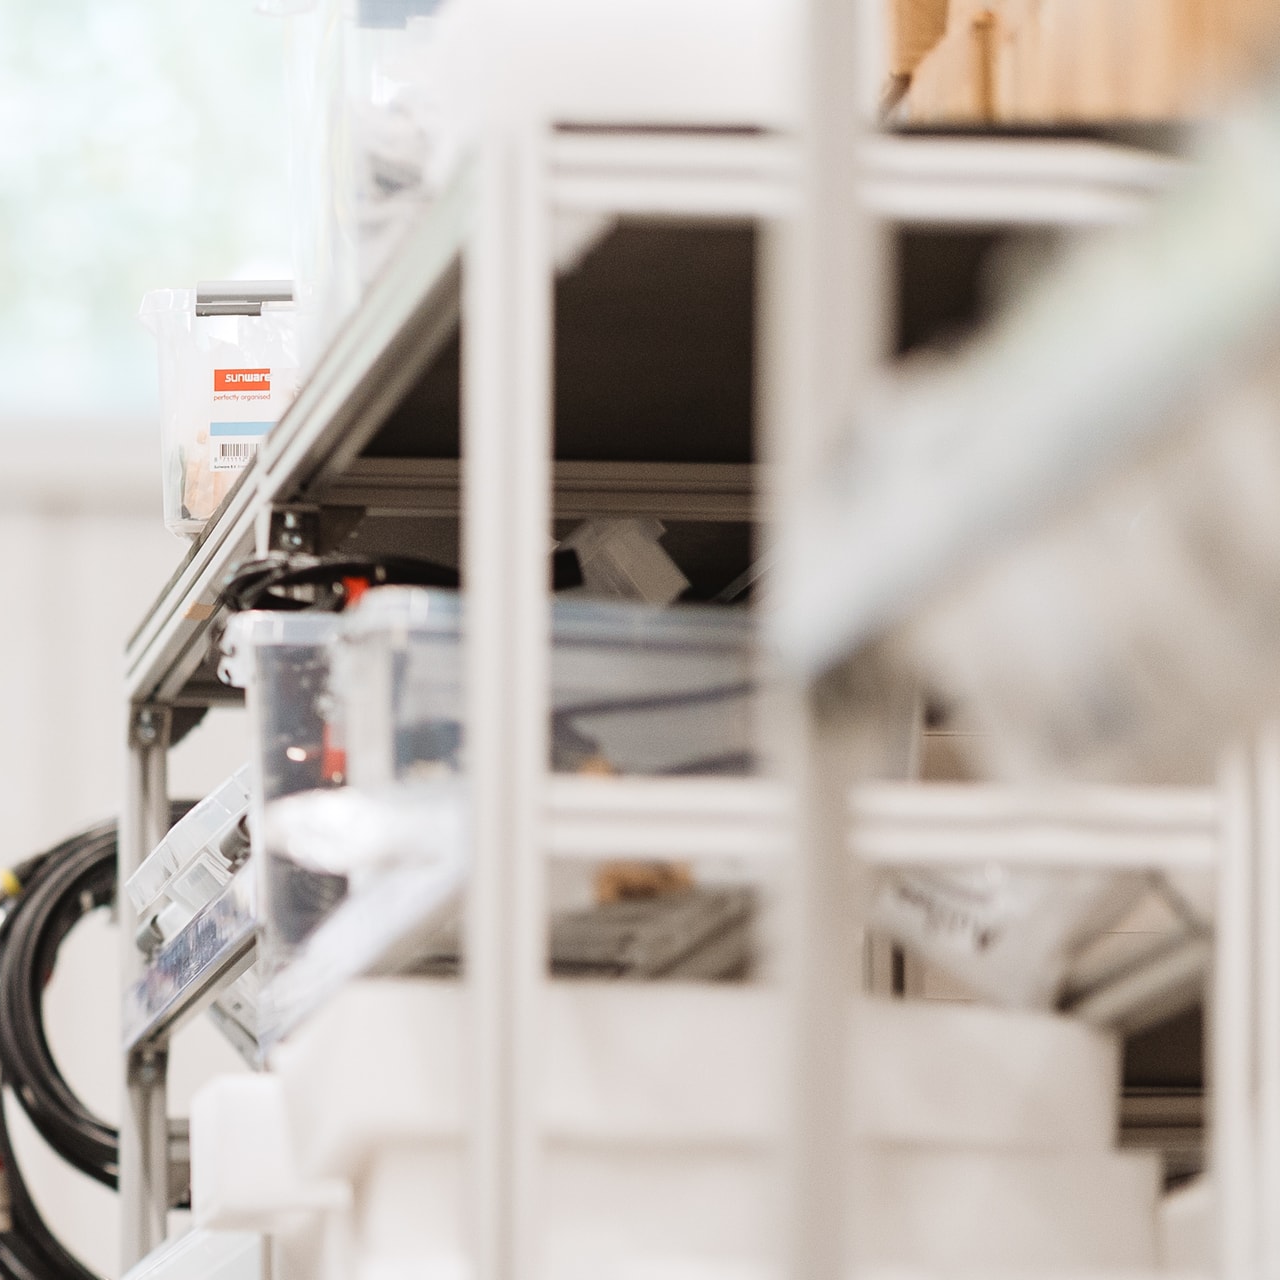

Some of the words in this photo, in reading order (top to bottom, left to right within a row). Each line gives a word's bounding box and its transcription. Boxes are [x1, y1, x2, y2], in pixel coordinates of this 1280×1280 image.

[224, 373, 271, 383] sunware
[213, 394, 239, 402] perfectly
[240, 393, 271, 402] organised
